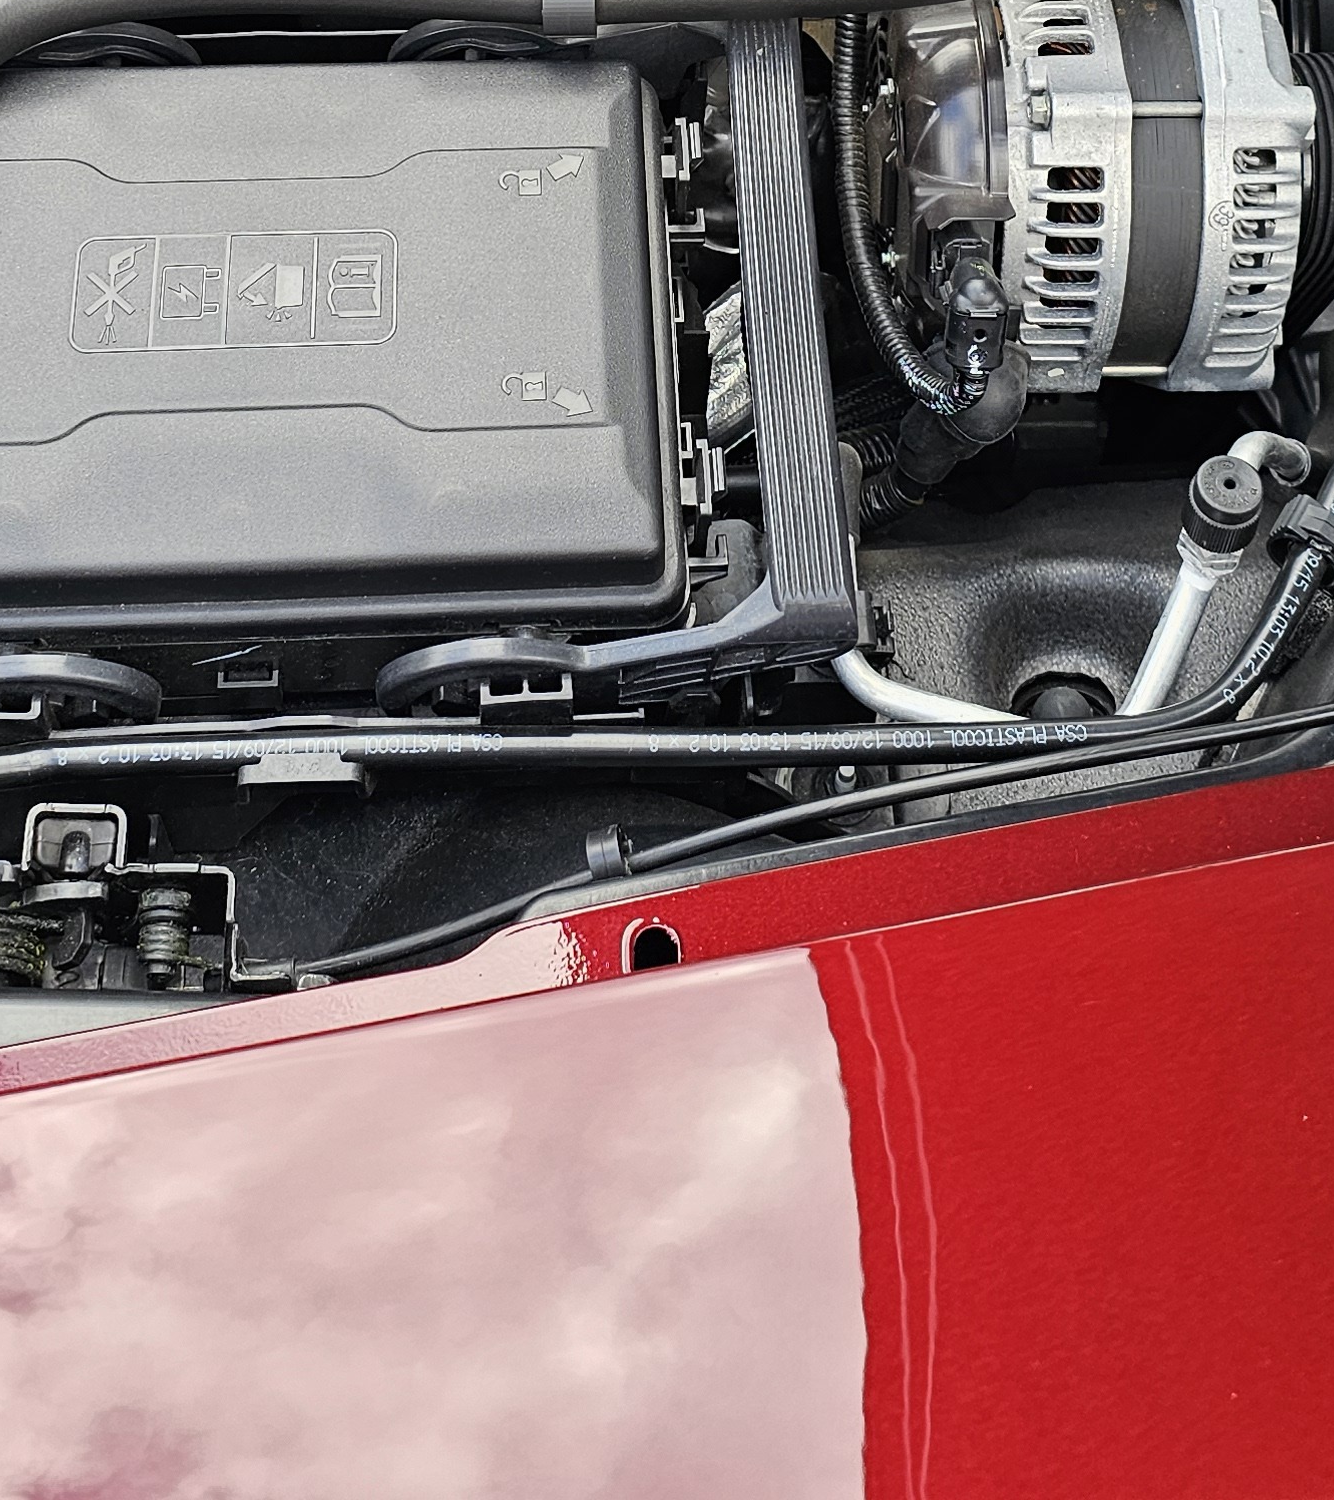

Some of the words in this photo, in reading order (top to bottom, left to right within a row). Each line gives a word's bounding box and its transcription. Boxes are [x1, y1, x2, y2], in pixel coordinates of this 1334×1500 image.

[1269, 593, 1301, 639] 13:03
[1244, 639, 1275, 677] 10.2
[471, 733, 504, 753] CSA
[647, 733, 660, 753] 8
[688, 732, 730, 753] 10.2
[739, 731, 790, 752] 13:03
[799, 730, 883, 751] 12/09/15
[892, 729, 934, 749] 1000
[943, 724, 1048, 749] PLASTICOOL
[1055, 723, 1089, 743] CSA
[148, 742, 201, 762] 13:03
[212, 738, 295, 760] 12/09/15
[304, 735, 349, 756] 1000
[359, 733, 462, 756] PLASTICOOL
[57, 748, 69, 767] 8
